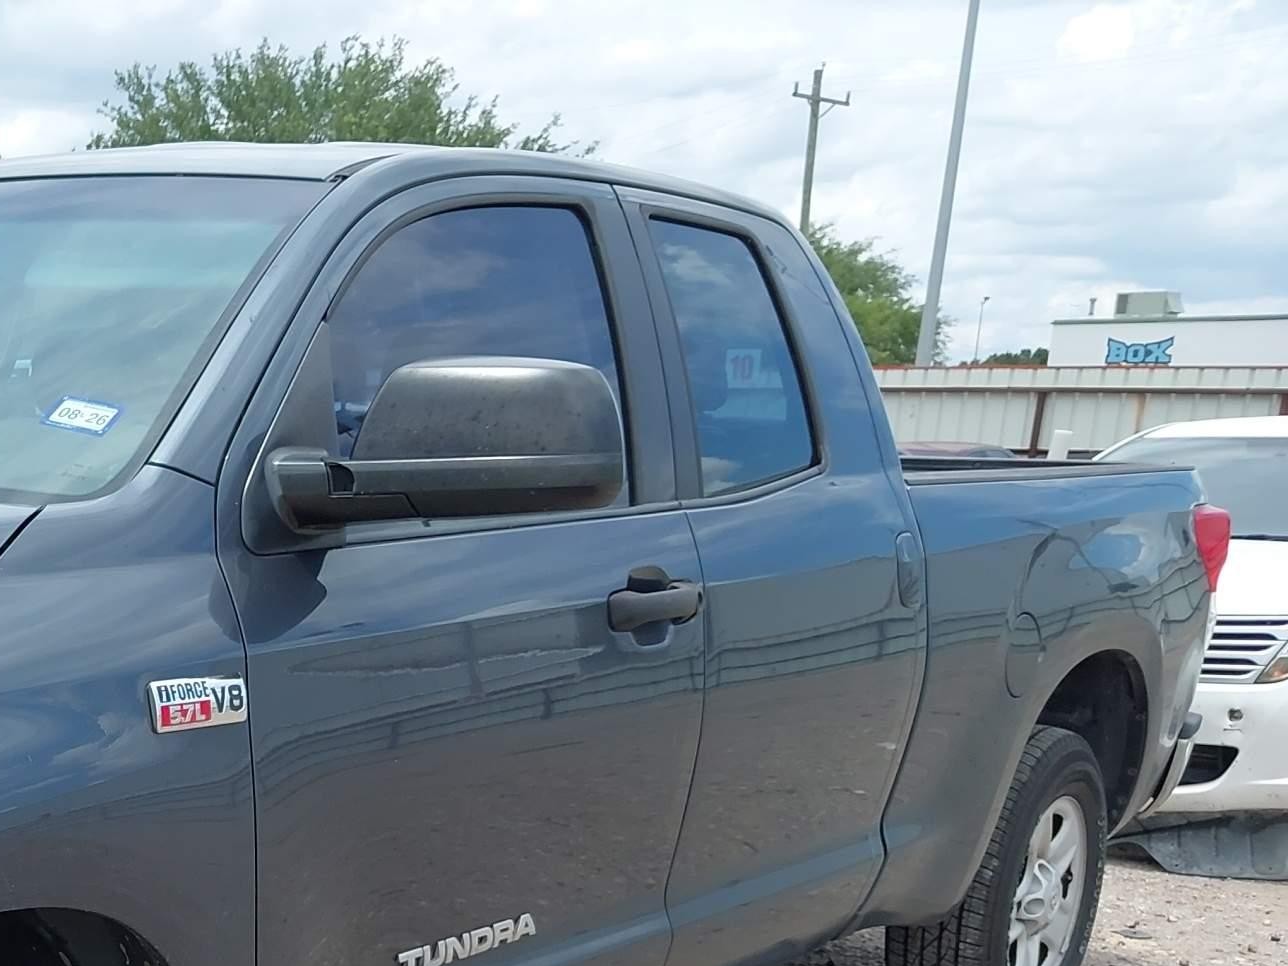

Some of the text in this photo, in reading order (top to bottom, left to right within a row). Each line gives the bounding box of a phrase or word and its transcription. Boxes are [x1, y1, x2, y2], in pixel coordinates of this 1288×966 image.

[1105, 336, 1175, 364] BOX
[57, 407, 81, 420] 08
[85, 412, 109, 426] 26
[211, 684, 244, 713] V8
